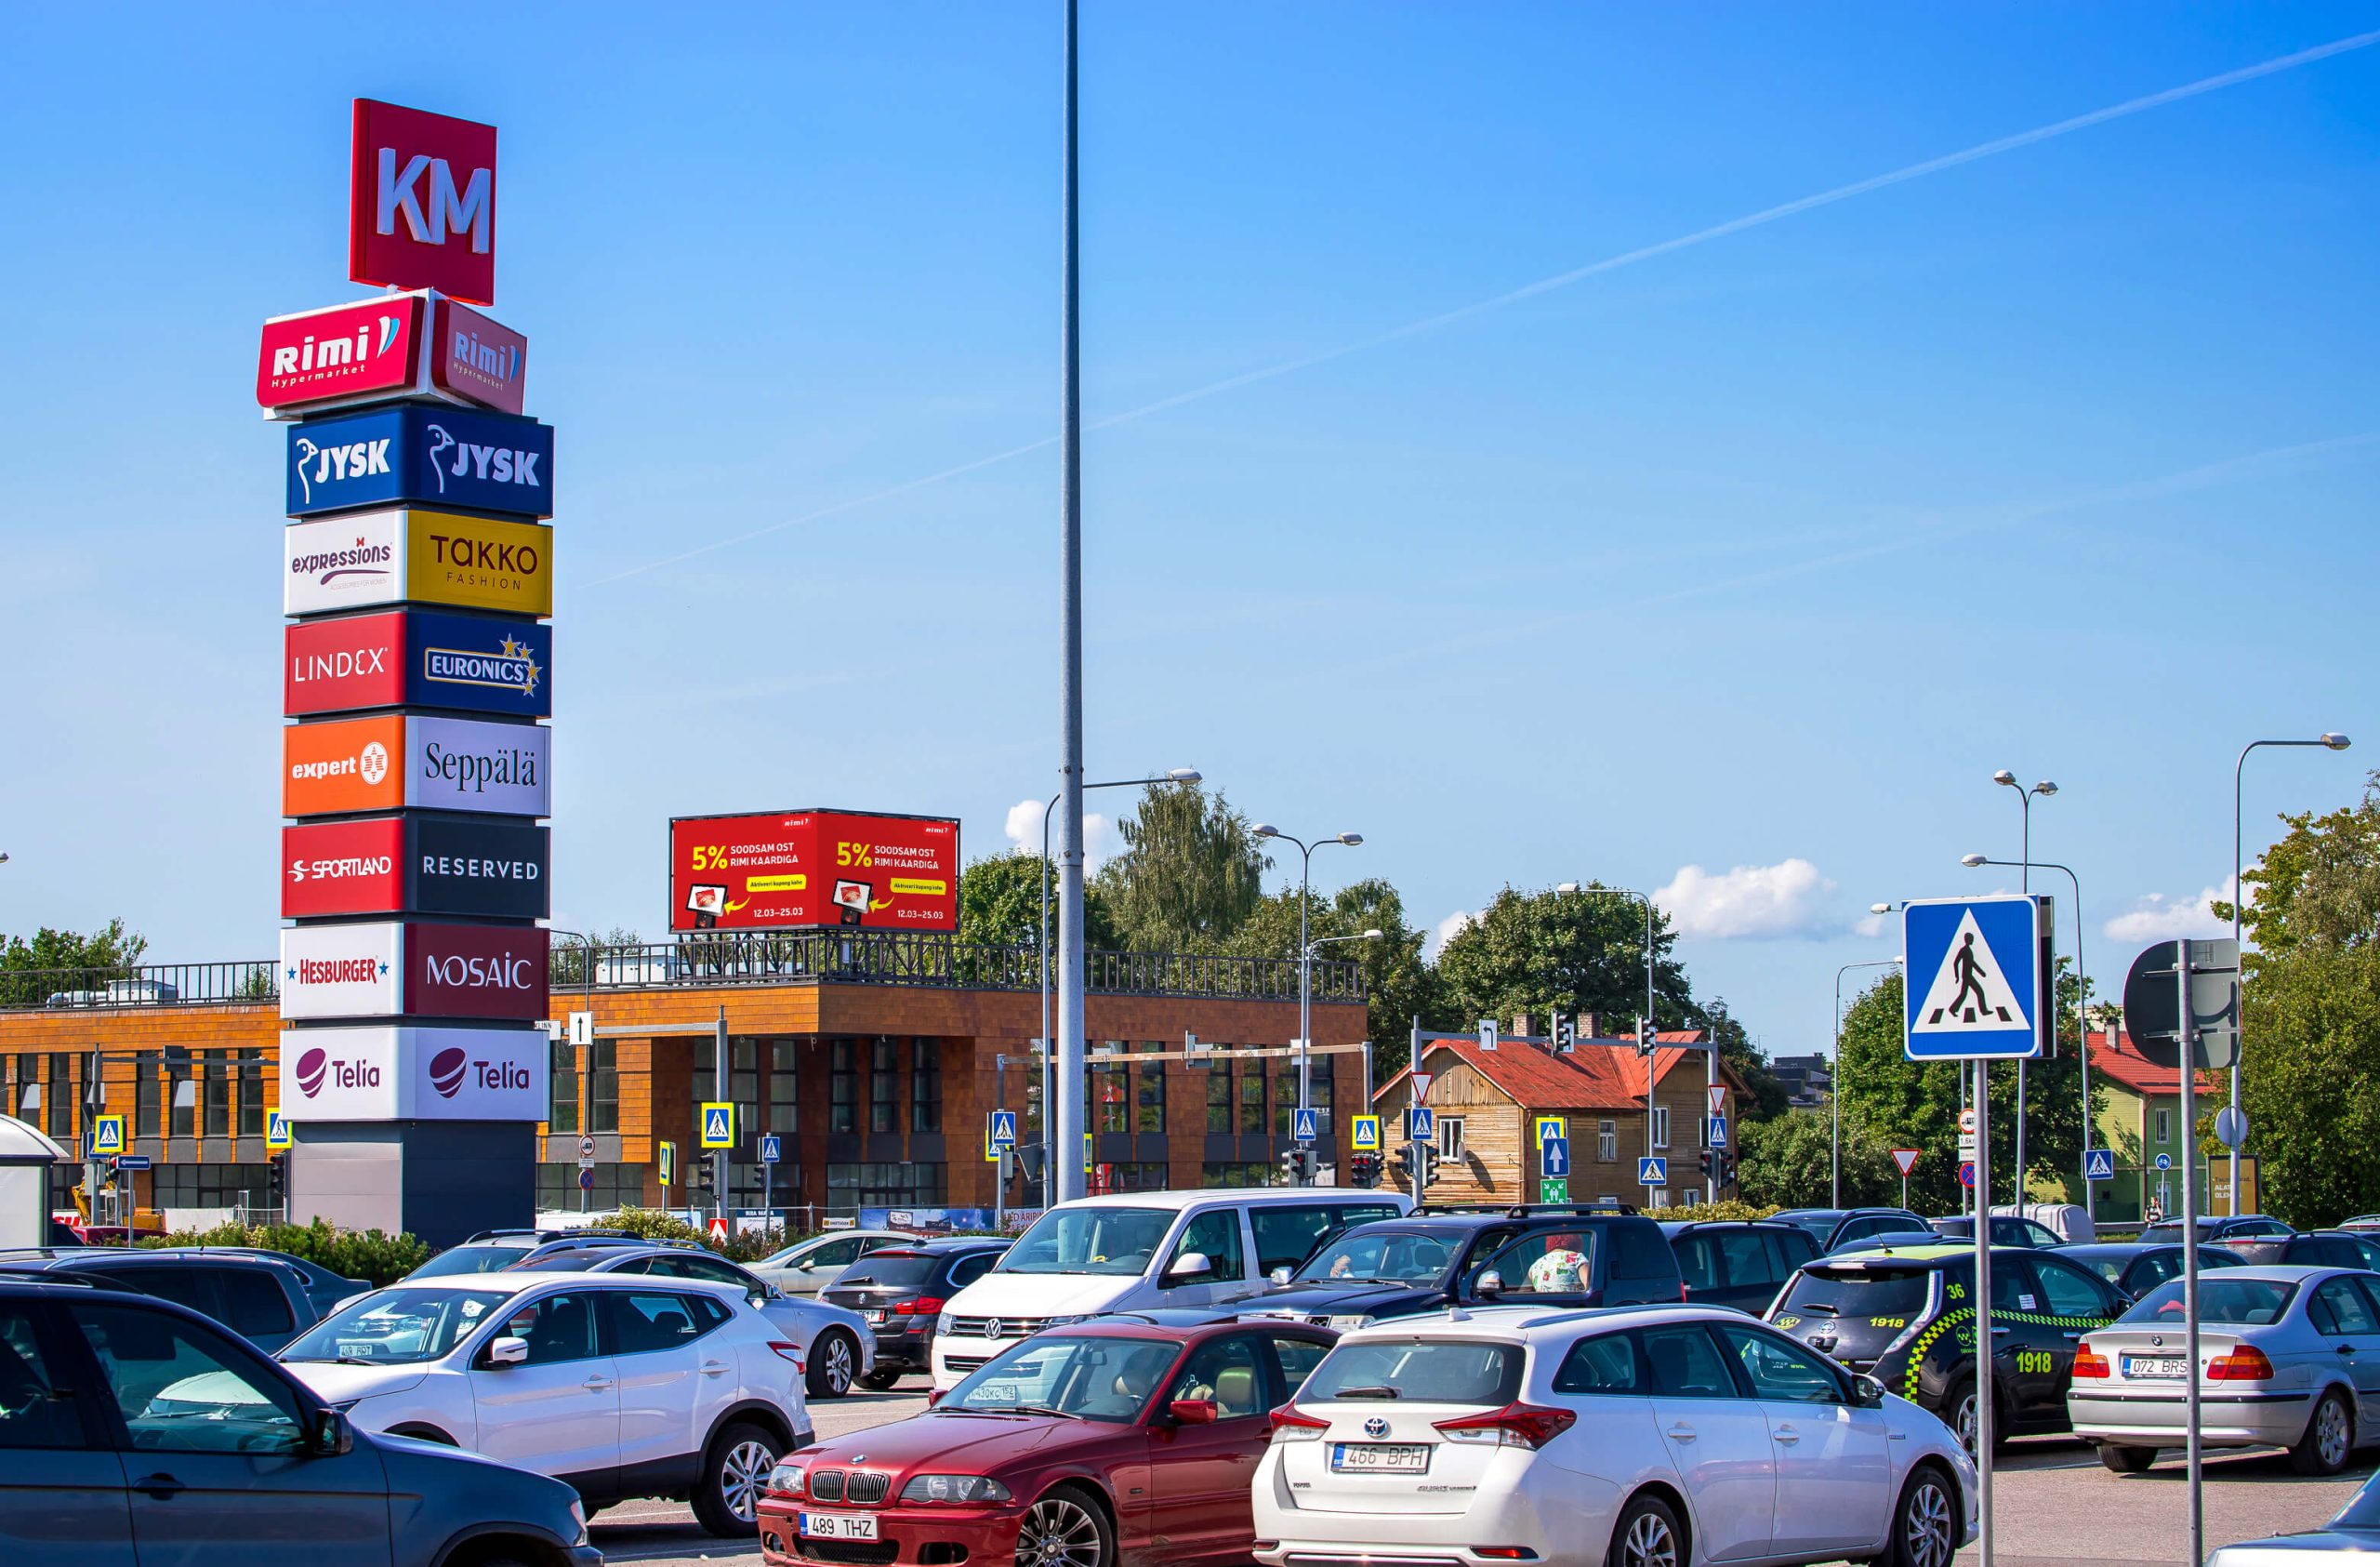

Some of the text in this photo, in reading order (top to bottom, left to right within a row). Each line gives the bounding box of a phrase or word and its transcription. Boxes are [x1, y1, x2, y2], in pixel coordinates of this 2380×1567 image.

[377, 147, 491, 254] KM
[272, 325, 370, 377] Rimi
[455, 331, 507, 380] Rimi
[271, 364, 365, 388] Hypermarket
[453, 361, 504, 391] Hypermarket
[314, 438, 391, 484] JYSK
[451, 443, 540, 486] JYSK
[292, 540, 391, 574] expressions
[446, 571, 522, 591] FASHION
[295, 647, 385, 682] LINDEX
[431, 655, 524, 683] EURONICS
[292, 756, 357, 779] expert
[425, 742, 537, 792] Seppälä
[692, 845, 728, 870] 5%
[731, 843, 794, 855] SOODSAM OST
[731, 855, 799, 867] RIMI KAARDIGA
[837, 842, 872, 868] 5%
[875, 845, 935, 857] SOODSAM OST
[311, 857, 391, 879] SPORTLAND
[423, 856, 539, 880] RESERVED
[875, 857, 939, 870] RIMI KAARDIGA
[300, 959, 377, 984] HESBURGER
[332, 1058, 380, 1088] Telia
[473, 1060, 530, 1090] Telia
[1947, 1283, 1964, 1299] 36
[1870, 1318, 1905, 1328] 1918
[2016, 1352, 2052, 1373] 1918
[2134, 1361, 2188, 1373] 072 BRS
[1349, 1447, 1376, 1465] 466
[1387, 1447, 1423, 1466] BPH
[813, 1518, 873, 1537] 489 THZ
